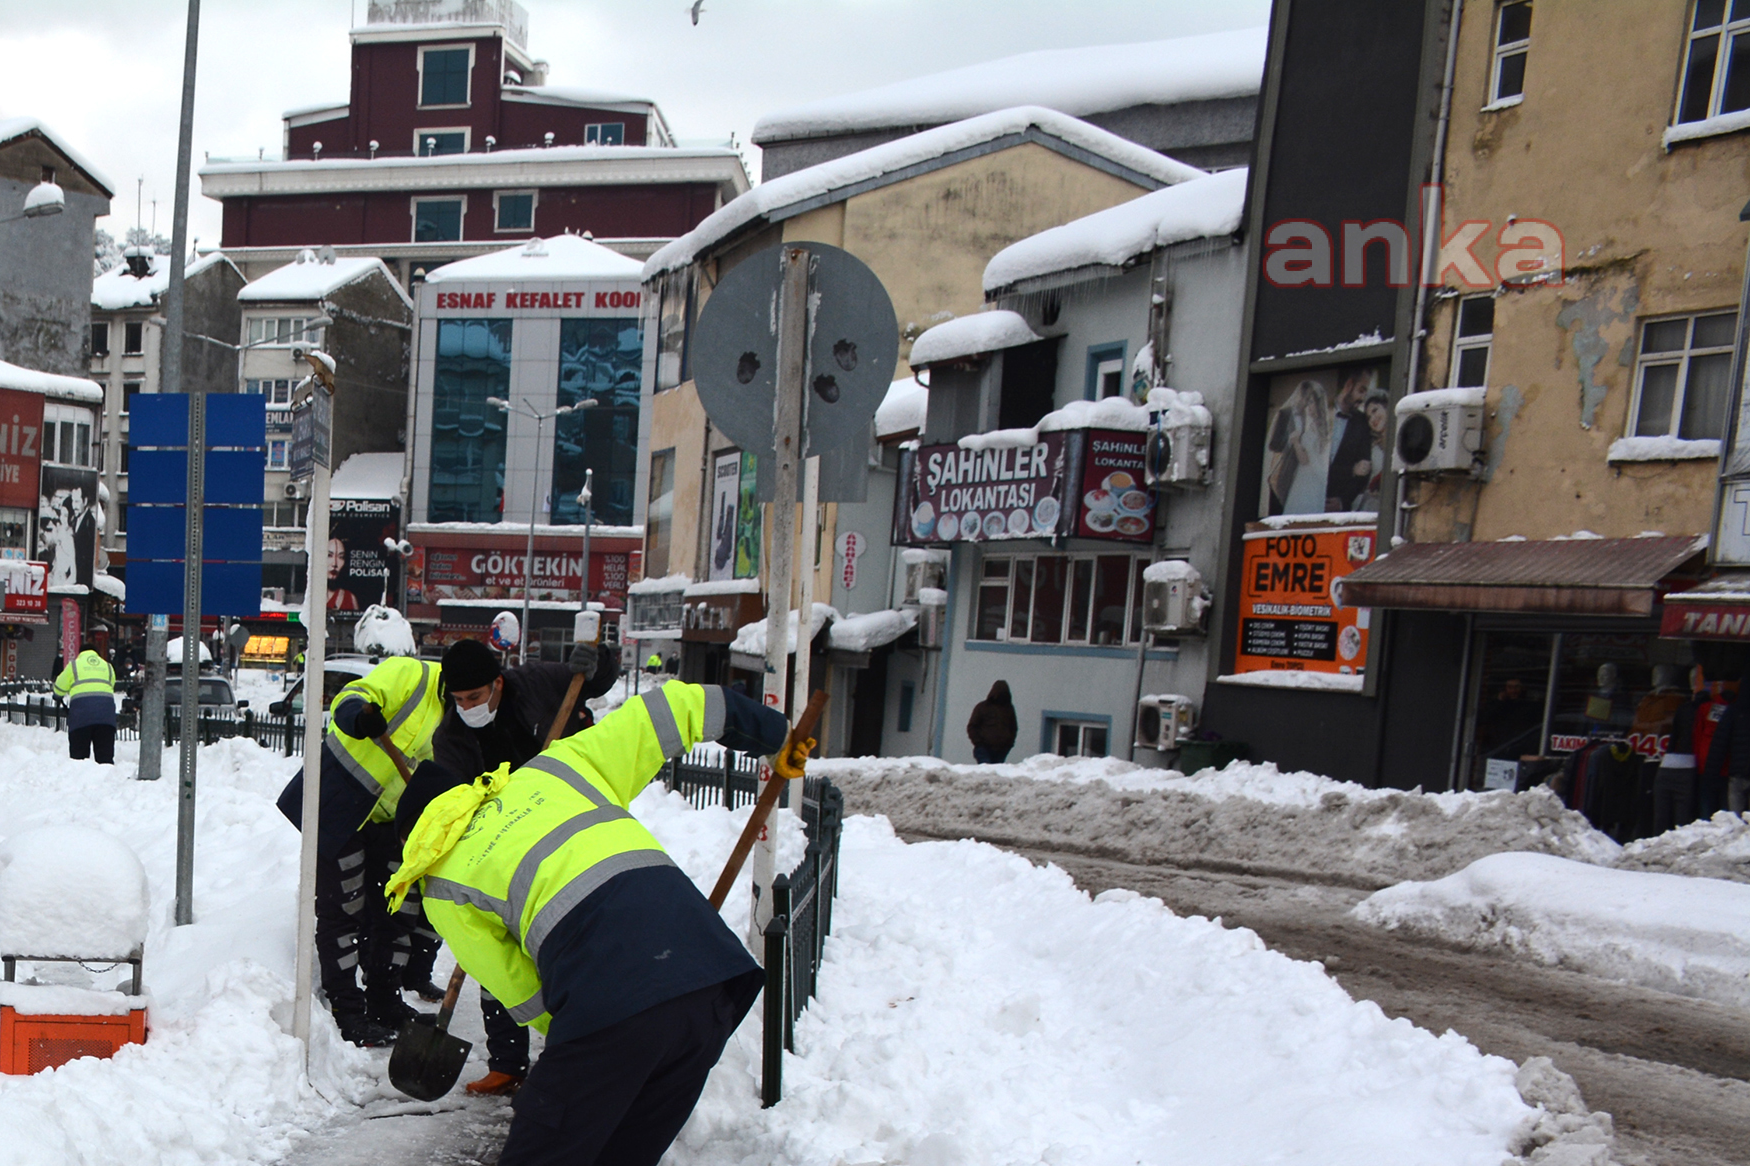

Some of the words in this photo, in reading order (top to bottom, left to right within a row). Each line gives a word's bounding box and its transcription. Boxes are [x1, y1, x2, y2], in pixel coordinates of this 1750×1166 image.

[437, 291, 496, 309] ESNAF
[505, 291, 585, 309] KEFALET
[716, 460, 739, 479] SCOOTER
[346, 500, 390, 513] Polisan
[939, 483, 1037, 513] LOKANTASI
[1264, 533, 1317, 559] FOTO
[471, 550, 584, 578] GÖKTEKİN
[485, 576, 497, 586] et
[498, 577, 512, 586] ve
[513, 576, 525, 587] et
[1253, 561, 1326, 593] EMRE
